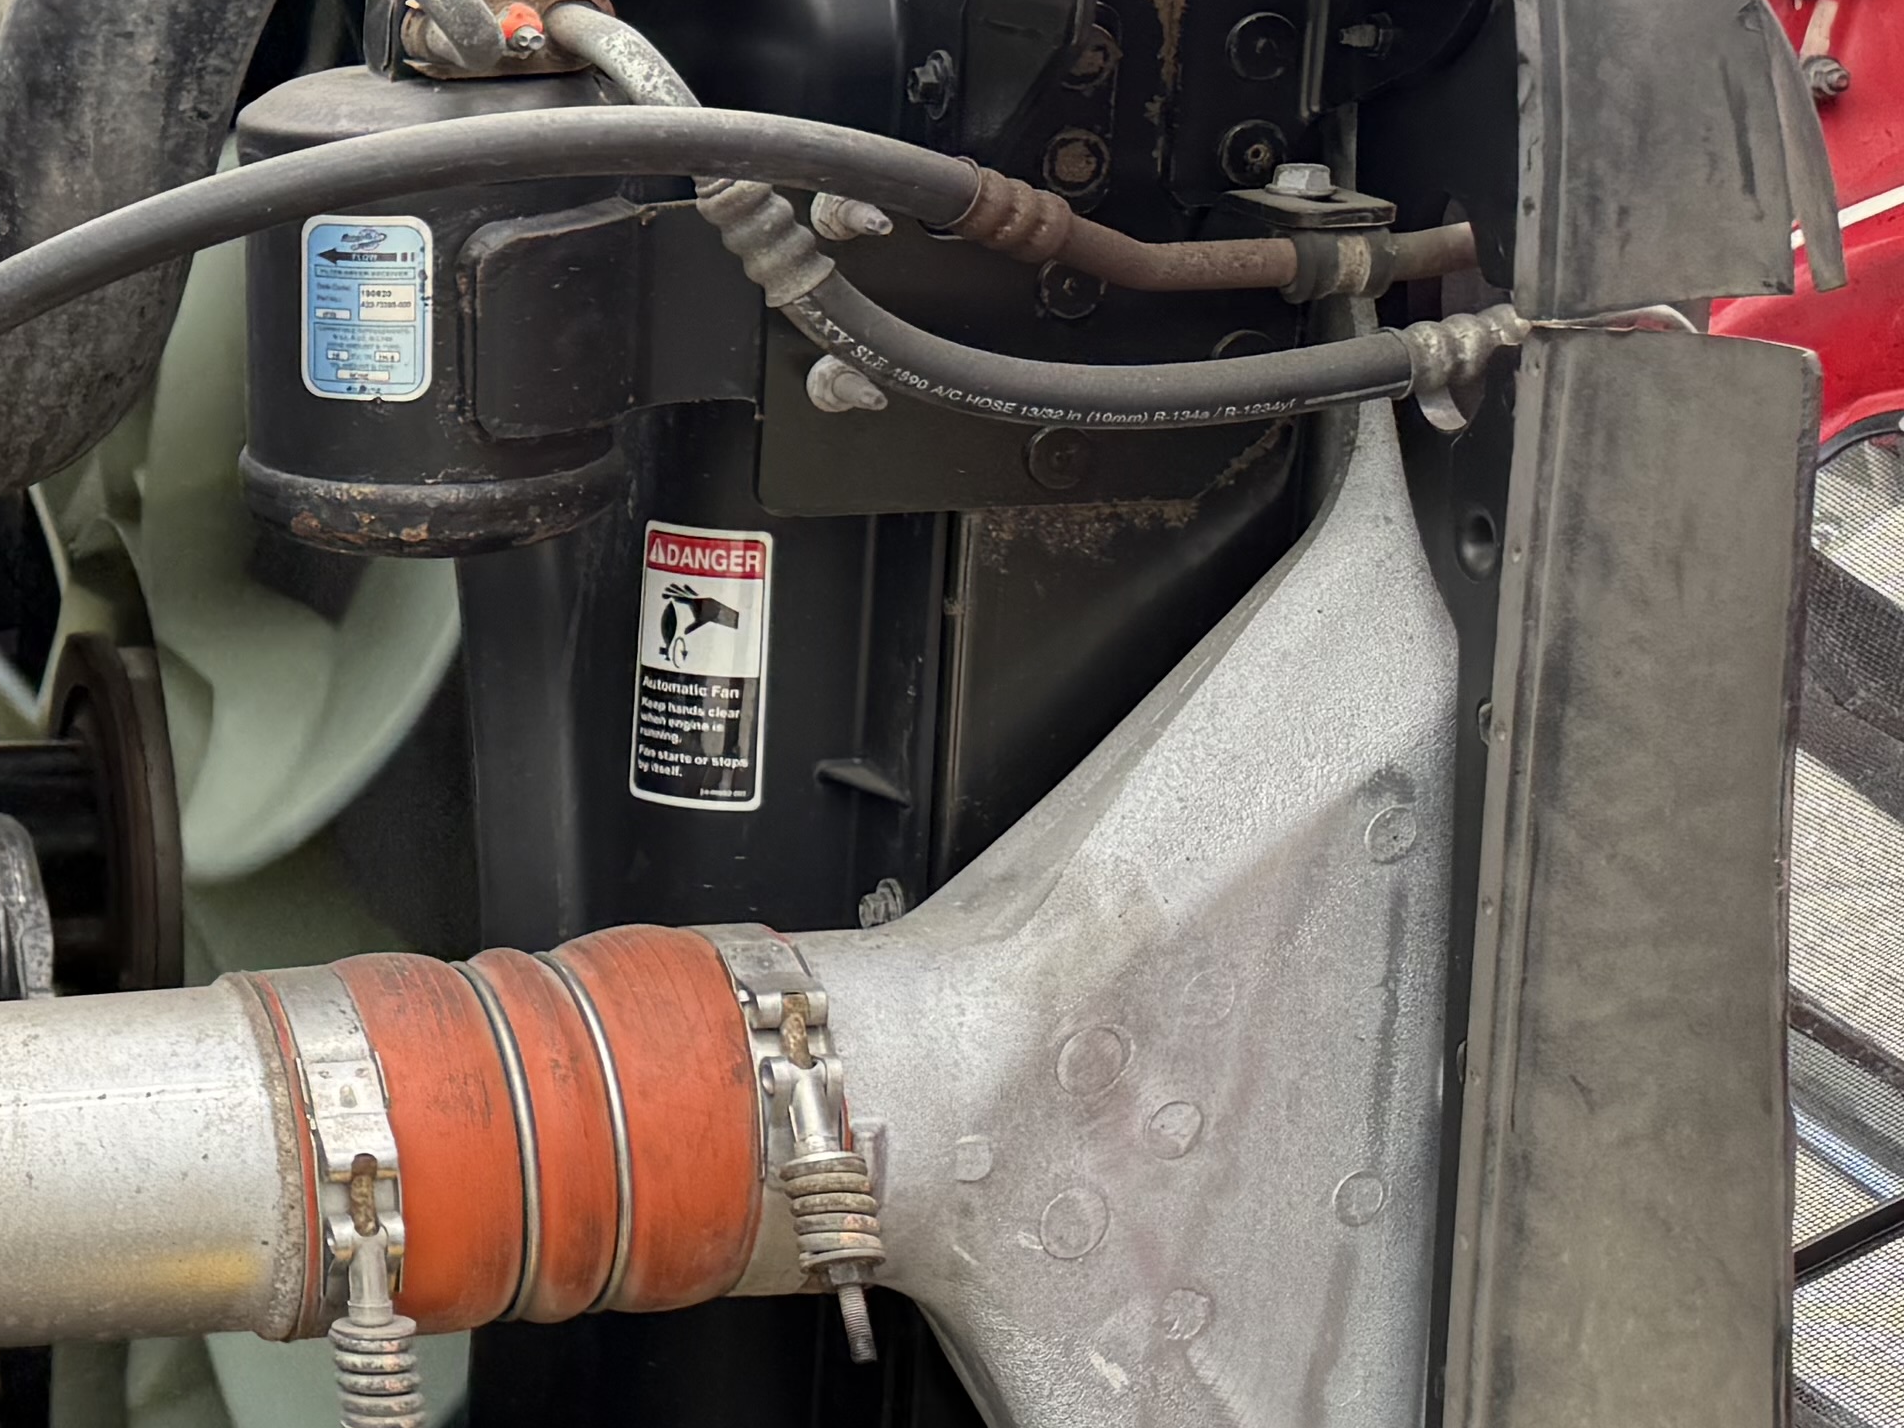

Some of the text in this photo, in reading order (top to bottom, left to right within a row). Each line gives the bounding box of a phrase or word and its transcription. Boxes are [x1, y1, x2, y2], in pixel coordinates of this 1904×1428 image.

[930, 384, 963, 402] A/C
[965, 393, 1017, 415] HOSE
[1067, 409, 1082, 422] in
[1086, 410, 1148, 424] (10mm)
[666, 543, 762, 573] DANGER
[642, 675, 740, 699] Automatic Fan
[668, 702, 705, 716] hands
[708, 707, 741, 719] clear
[668, 719, 710, 732] engine
[712, 723, 725, 732] is
[638, 744, 749, 769] Fan starts or stops
